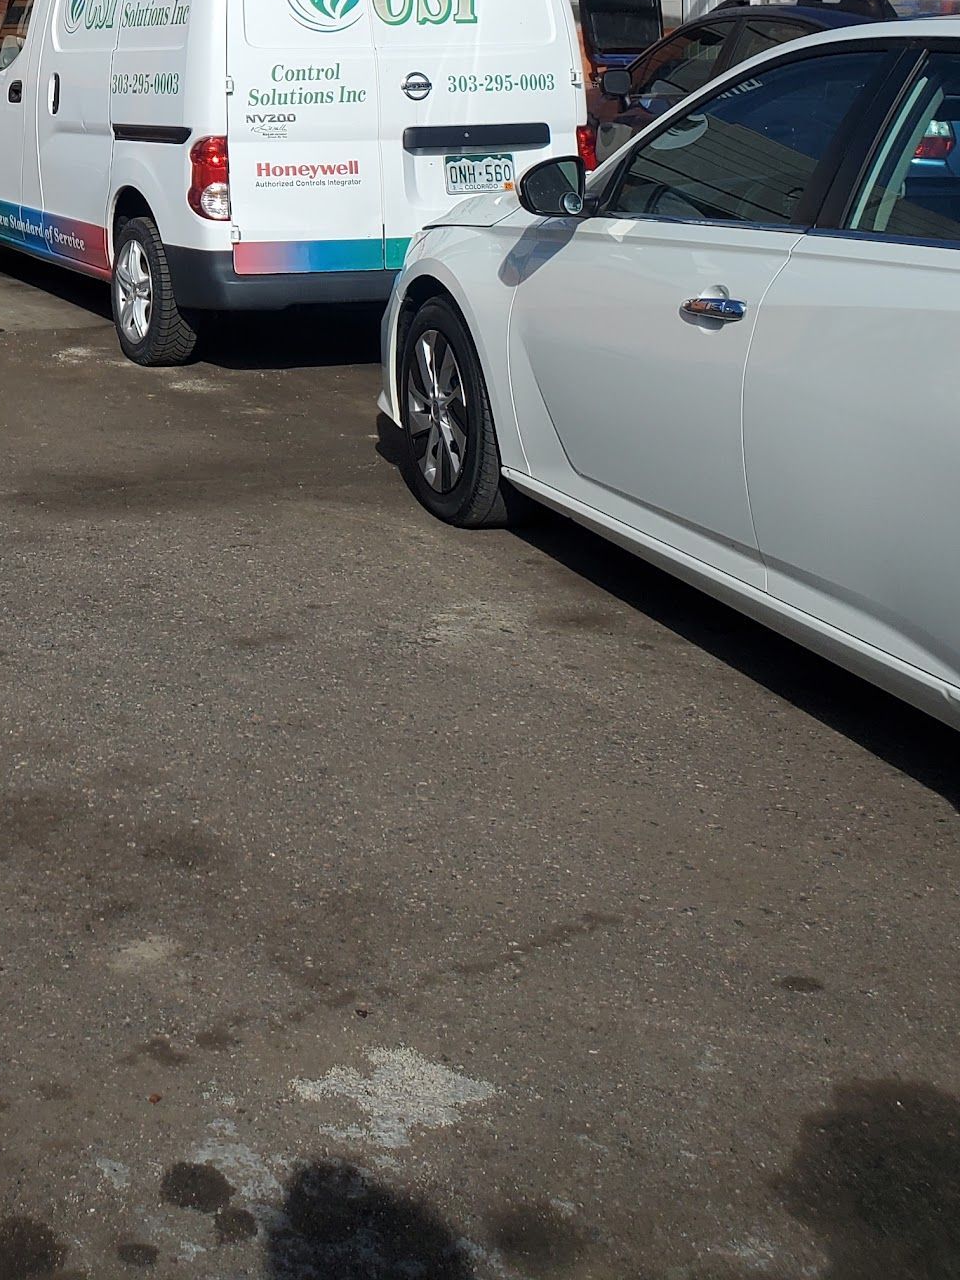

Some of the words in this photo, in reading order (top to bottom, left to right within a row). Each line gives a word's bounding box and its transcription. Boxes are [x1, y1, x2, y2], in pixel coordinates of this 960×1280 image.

[121, 0, 171, 29] Solutions
[111, 72, 180, 96] 303-295-0003
[271, 63, 341, 83] Control
[447, 72, 556, 94] 303-295-0003
[247, 87, 334, 107] Solutions
[338, 85, 367, 104] Inc
[245, 113, 297, 124] NV200
[256, 160, 359, 180] Honeywell
[255, 180, 294, 188] Authorized
[295, 179, 326, 187] Controls
[327, 178, 362, 187] Integrator
[9, 214, 44, 238] Standard
[44, 225, 53, 244] of
[53, 227, 86, 252] Service
